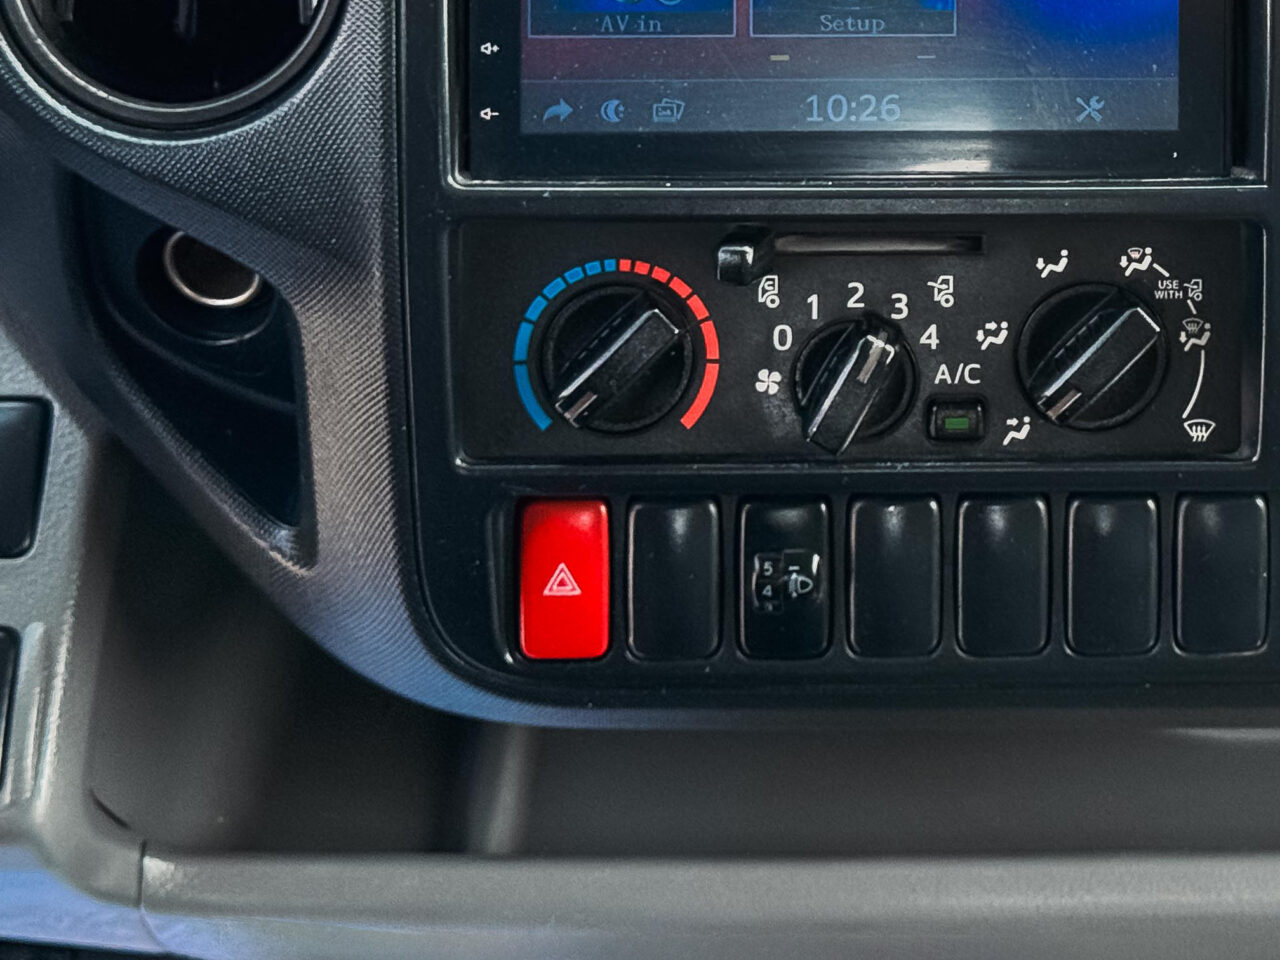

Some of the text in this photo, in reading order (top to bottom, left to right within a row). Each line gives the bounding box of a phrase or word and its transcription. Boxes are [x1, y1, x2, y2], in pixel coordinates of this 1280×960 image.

[600, 14, 662, 32] AV in
[820, 15, 885, 34] Setup
[806, 94, 900, 122] 10:26
[846, 282, 865, 308] 2
[1154, 290, 1183, 299] WITH
[1158, 280, 1179, 289] USE
[806, 294, 818, 320] 1
[890, 293, 909, 319] 3
[772, 324, 793, 351] 0
[919, 324, 940, 350] 4
[934, 363, 981, 384] A/C
[763, 561, 773, 576] 5
